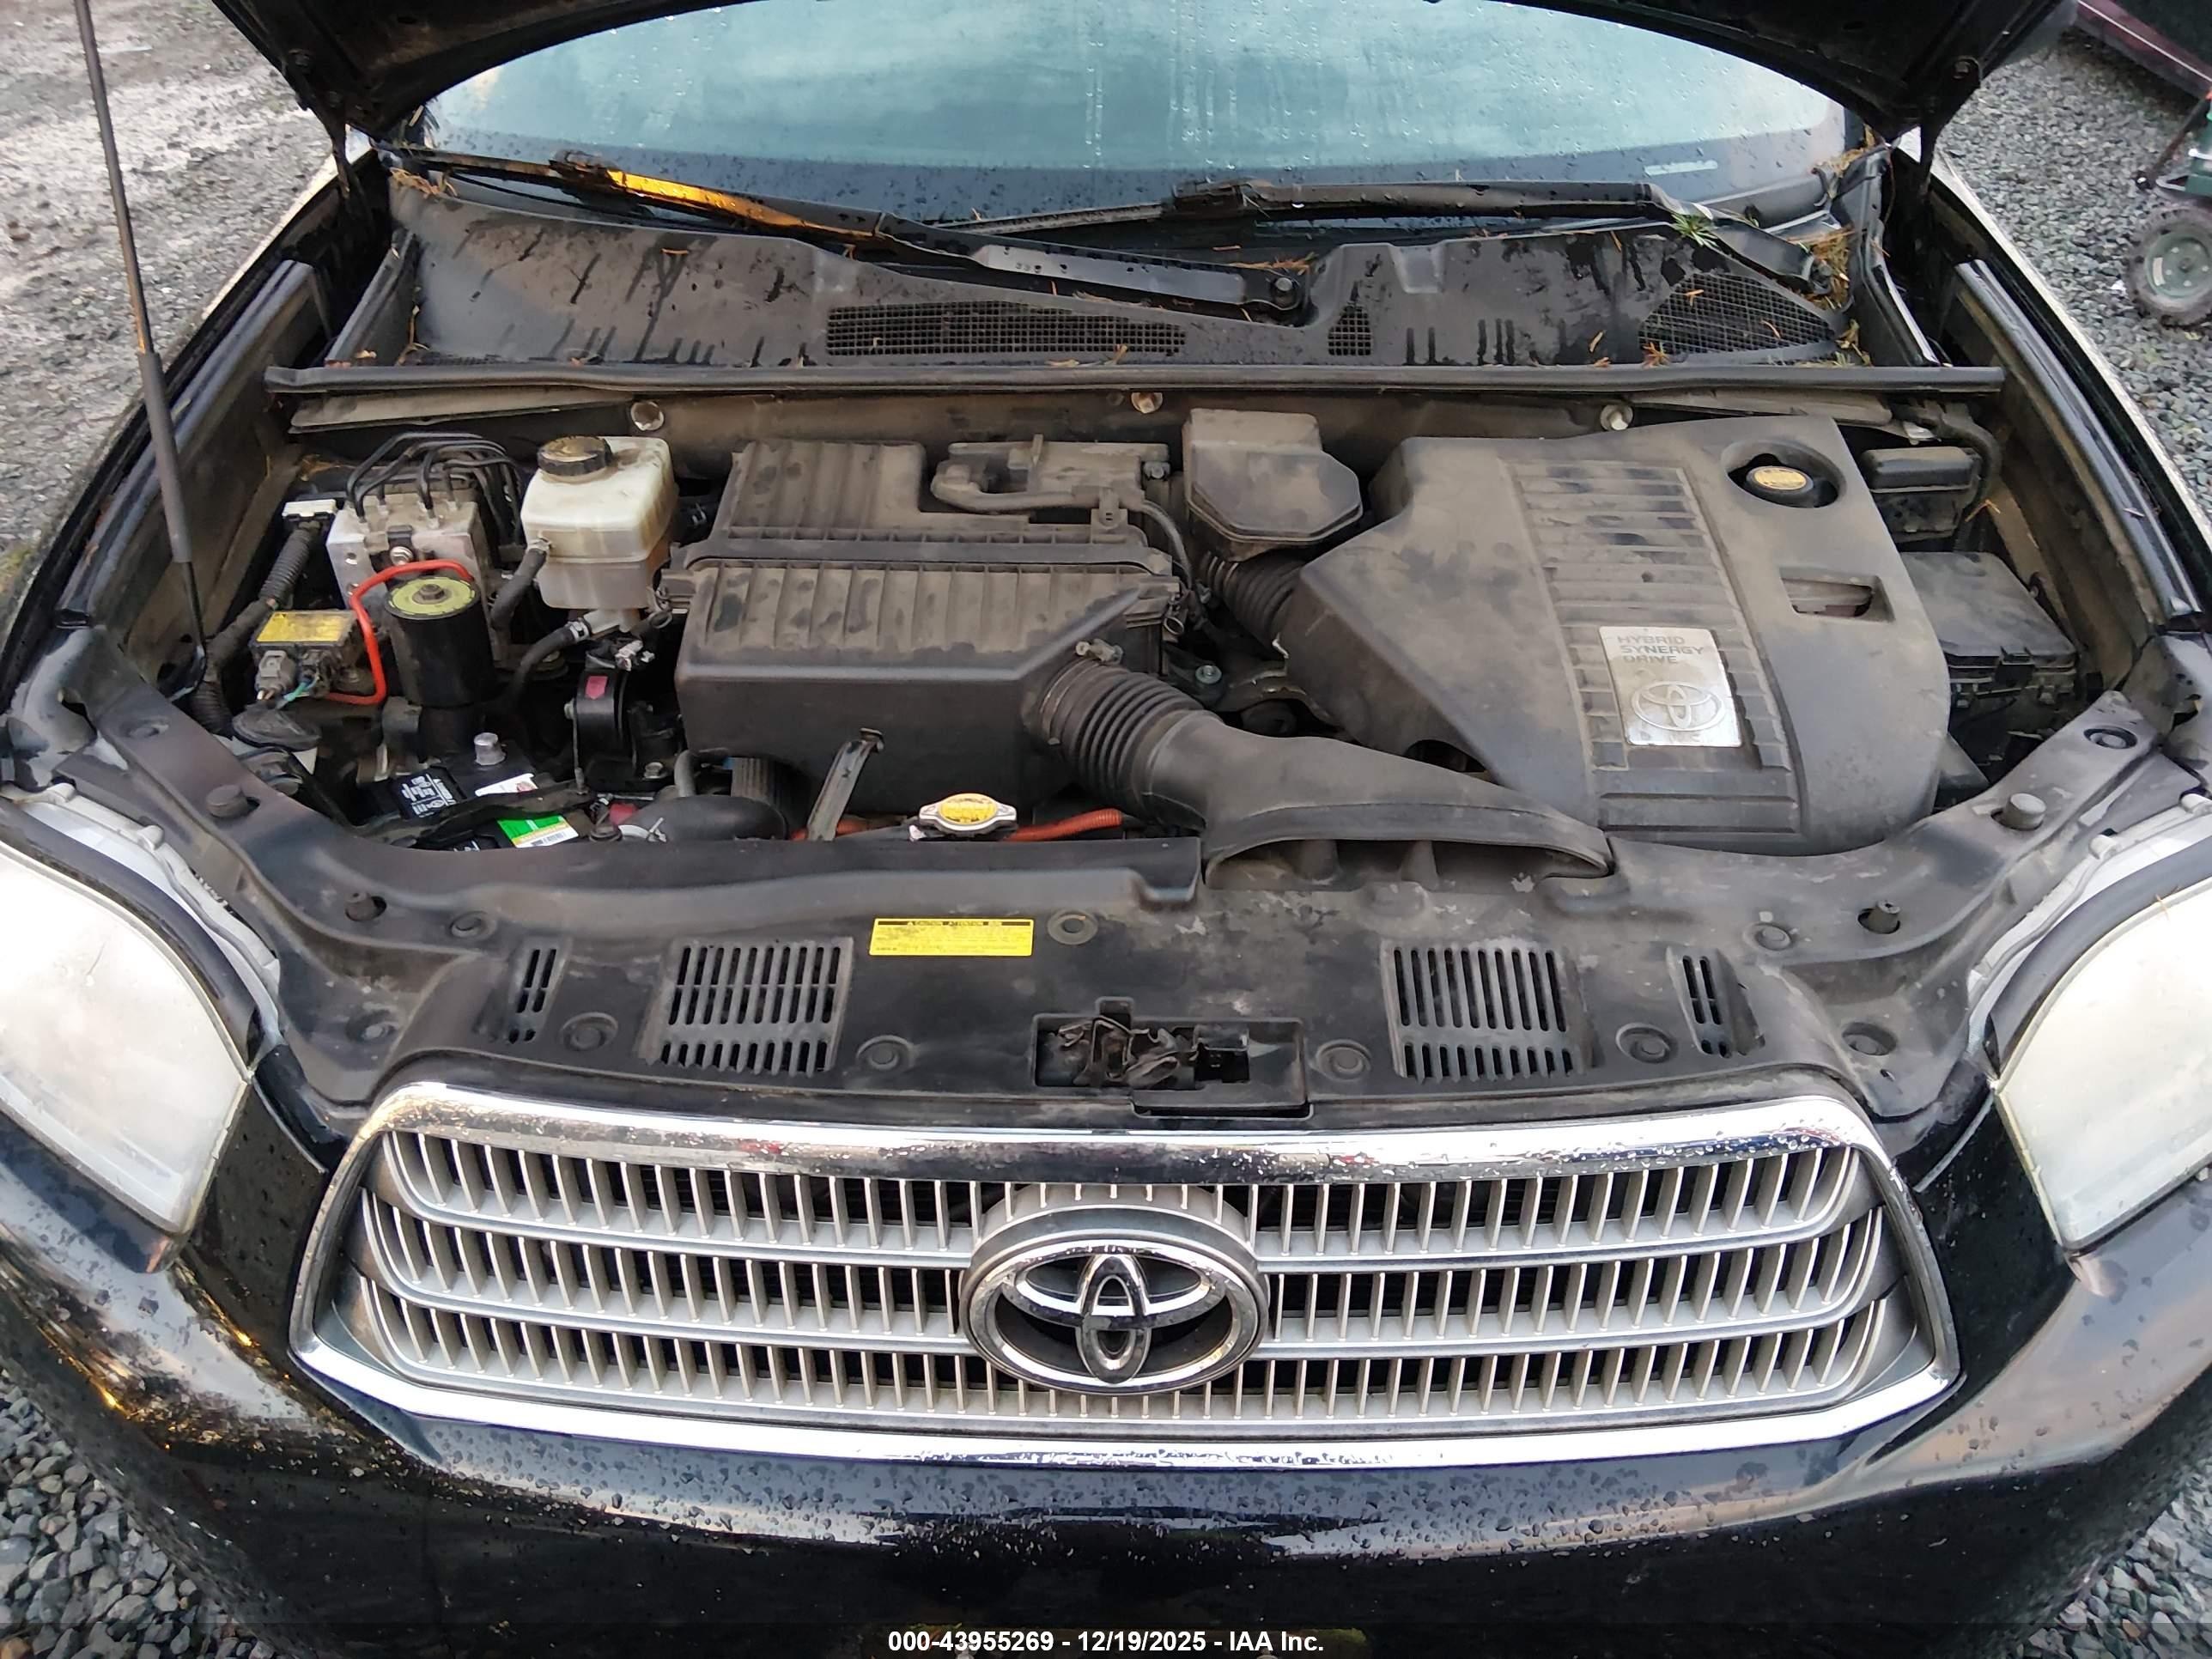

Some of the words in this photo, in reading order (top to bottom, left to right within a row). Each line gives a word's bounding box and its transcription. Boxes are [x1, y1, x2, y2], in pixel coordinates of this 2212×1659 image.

[1617, 635, 1686, 644] HYBRID
[1620, 645, 1704, 654] SYNERGY
[1622, 655, 1678, 664] DRIVE
